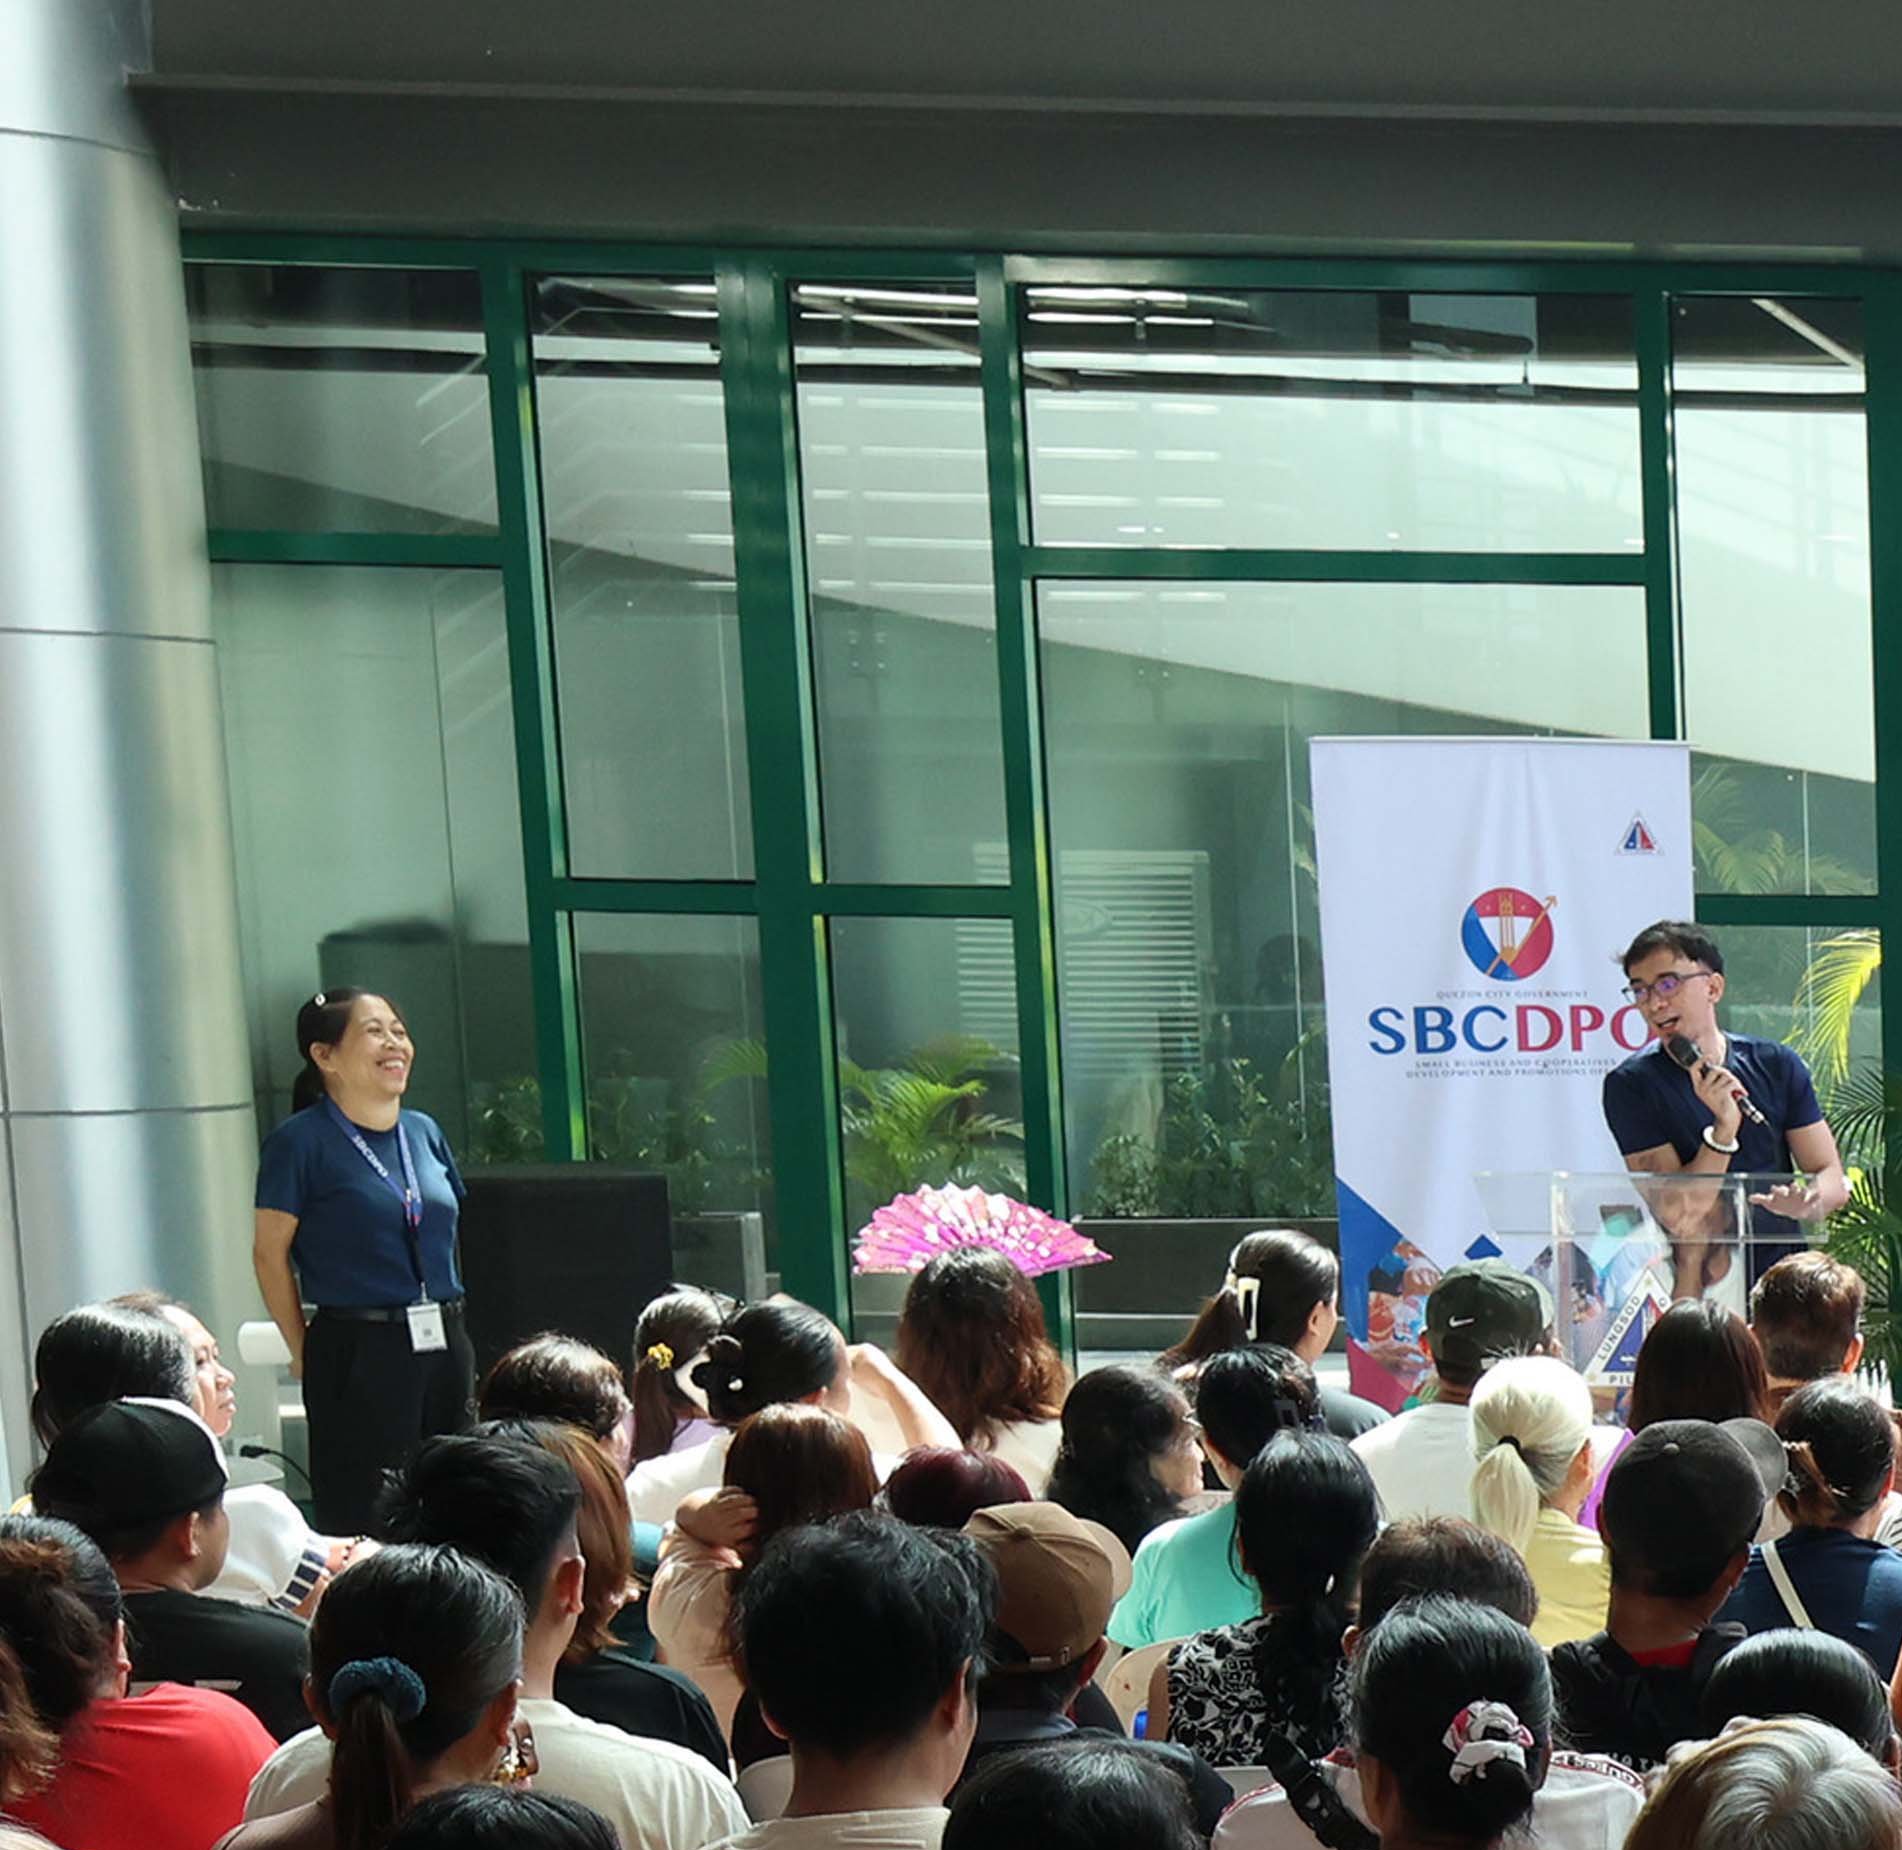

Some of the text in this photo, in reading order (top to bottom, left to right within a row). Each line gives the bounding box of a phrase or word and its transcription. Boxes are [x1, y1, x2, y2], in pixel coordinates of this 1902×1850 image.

[1485, 989, 1511, 1000] CITY
[1368, 1003, 1659, 1055] SBCDPO
[1599, 1295, 1642, 1362] LUNGSOD
